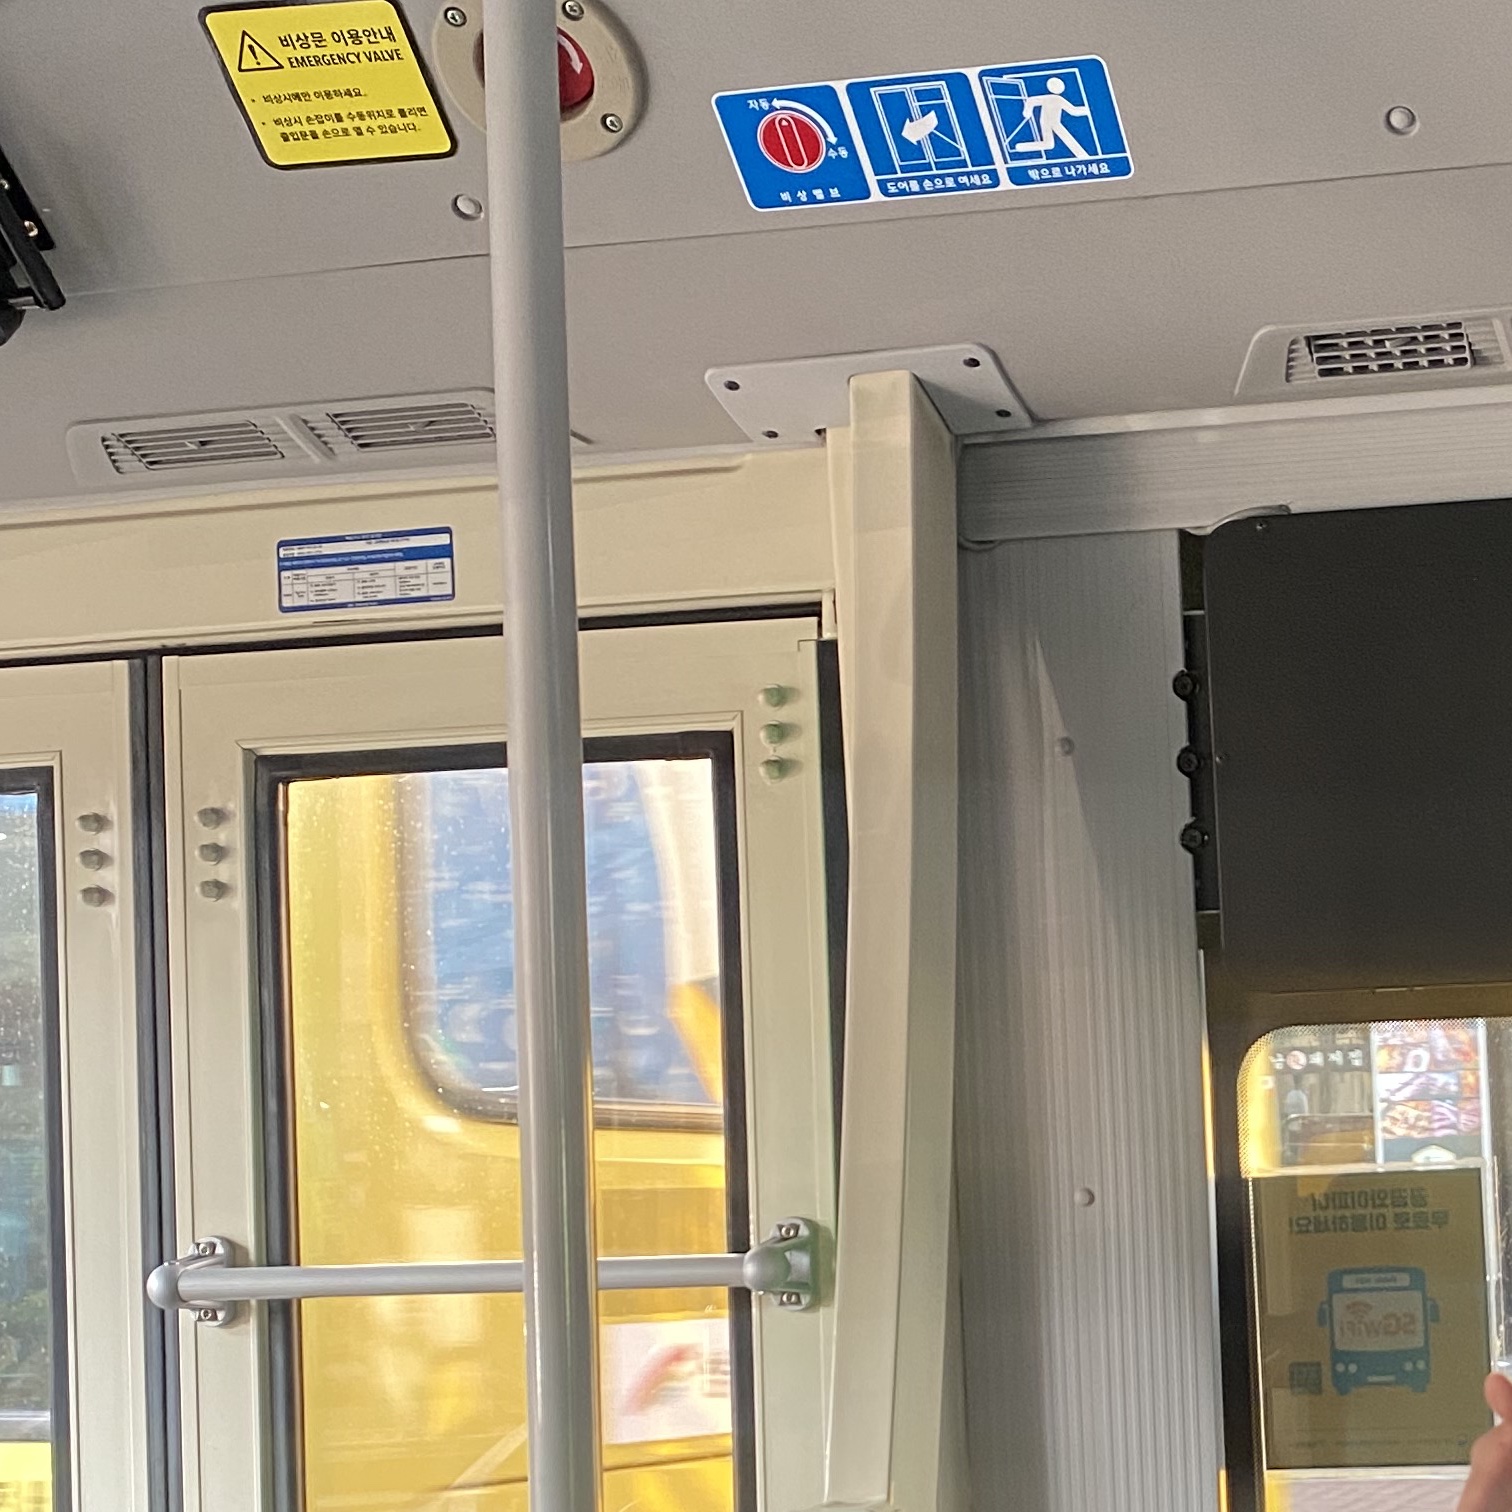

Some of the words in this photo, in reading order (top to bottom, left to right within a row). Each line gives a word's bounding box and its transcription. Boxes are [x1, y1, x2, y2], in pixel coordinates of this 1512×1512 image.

[278, 31, 328, 50] 비상문
[331, 26, 397, 46] 이용안내
[287, 52, 362, 69] EMERGENCY
[363, 48, 404, 63] VALVE
[263, 91, 313, 105] 비상시에만
[747, 98, 770, 111] 자동
[273, 115, 303, 127] 비상시
[322, 127, 351, 139] 손으로
[366, 126, 376, 136] 수
[828, 147, 849, 159] 수동
[1027, 165, 1063, 180] 밖으로
[1064, 162, 1111, 178] 나가세요
[886, 180, 920, 192] 도어를
[923, 177, 957, 191] 손으로
[958, 173, 993, 187] 여세요
